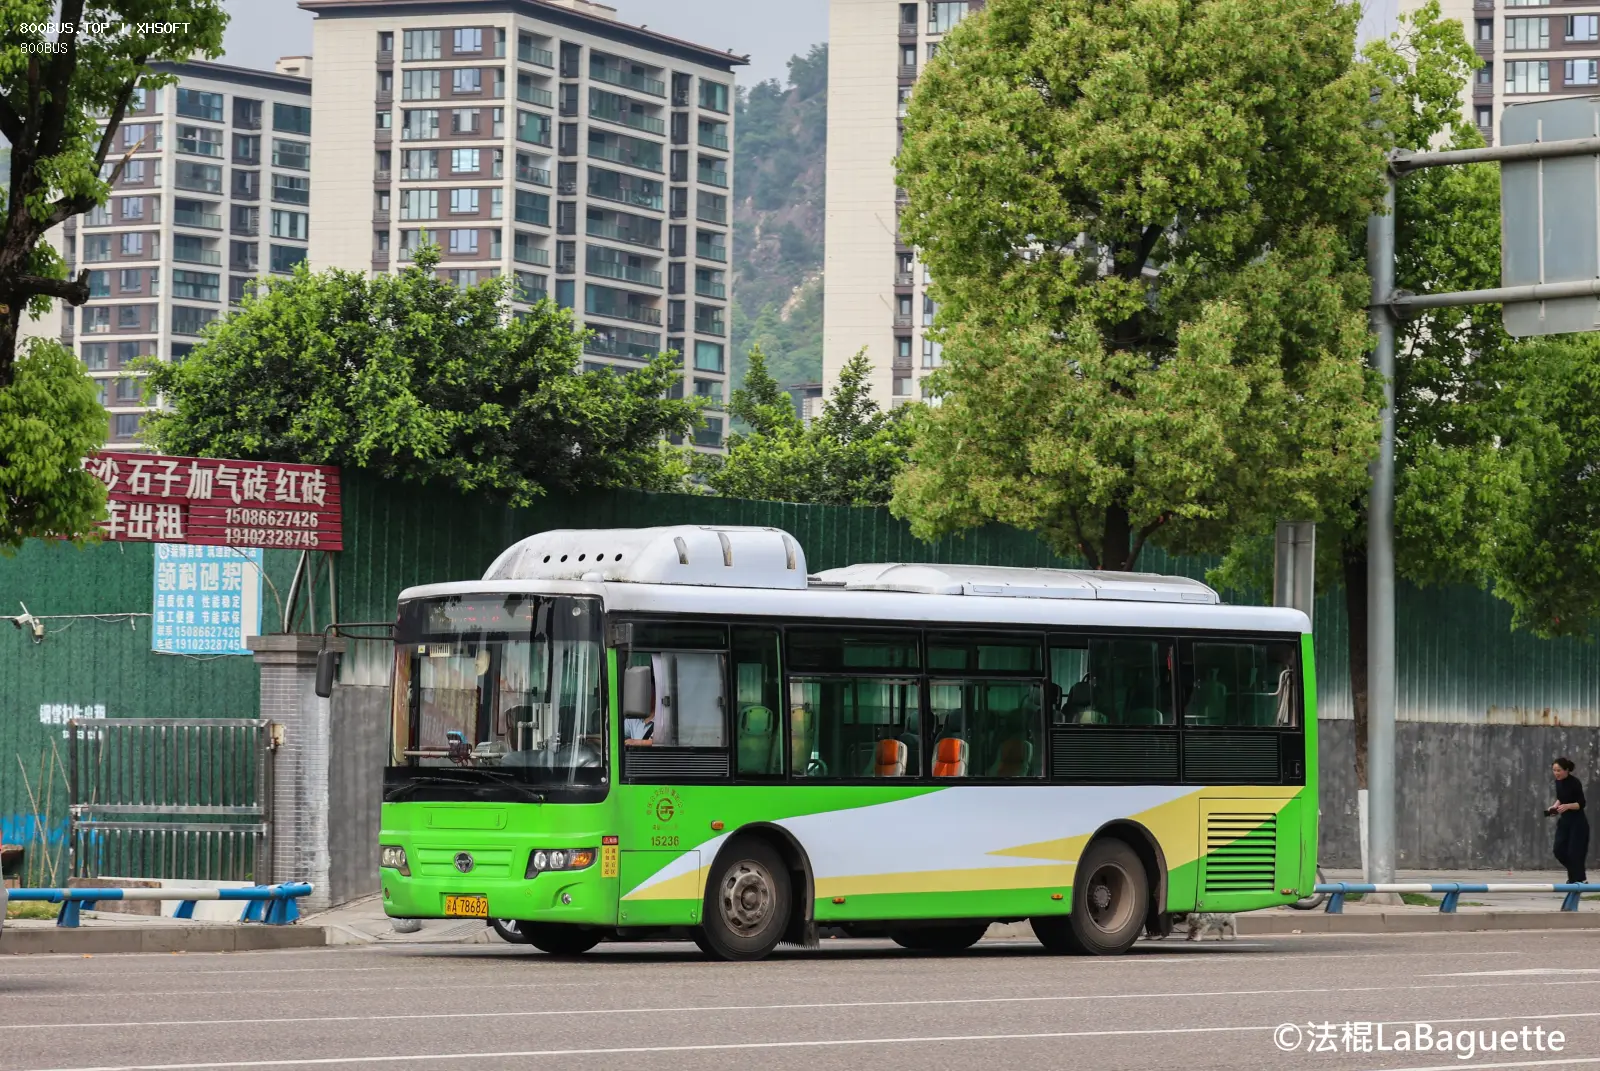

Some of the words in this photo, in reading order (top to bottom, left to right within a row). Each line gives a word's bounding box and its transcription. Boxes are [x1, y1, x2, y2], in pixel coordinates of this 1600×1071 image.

[126, 459, 181, 497] 石子
[185, 460, 268, 504] 加气砖
[275, 467, 327, 507] 红砖
[225, 507, 319, 528] 15086627426
[225, 528, 319, 546] 19102328745
[175, 626, 240, 638] 15086627426
[175, 638, 240, 650] 19102328745
[651, 835, 680, 847] 15236
